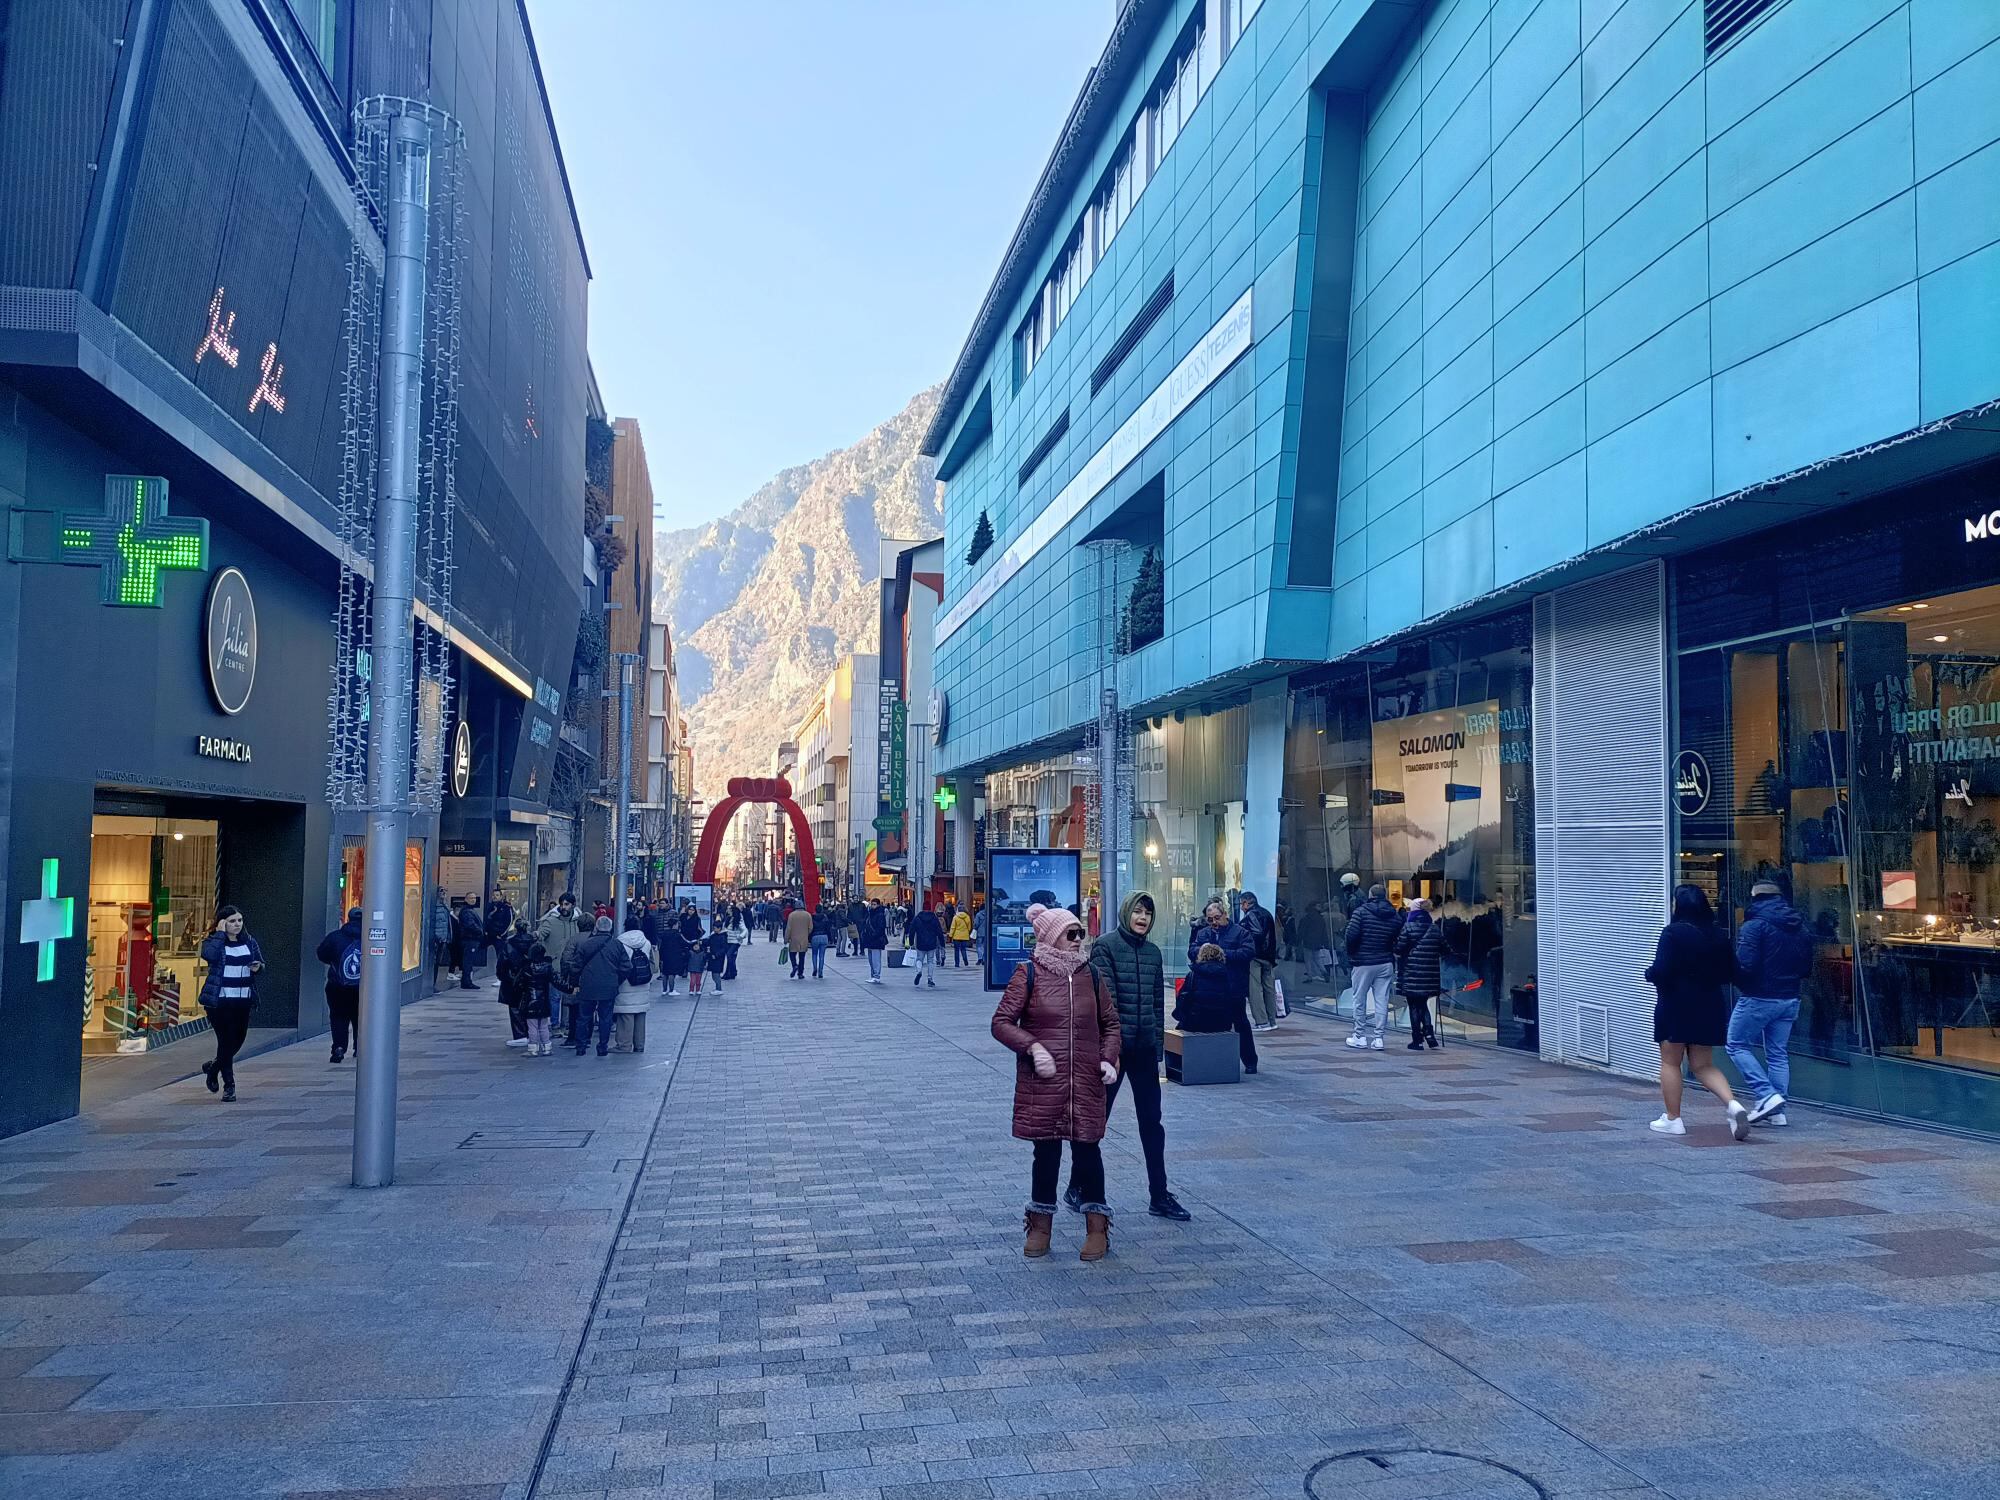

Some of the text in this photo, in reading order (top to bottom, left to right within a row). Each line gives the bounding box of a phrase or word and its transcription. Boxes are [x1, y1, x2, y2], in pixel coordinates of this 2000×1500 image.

[1172, 348, 1206, 406] GUESS
[217, 595, 249, 670] Júlia
[224, 657, 246, 673] CENTRE
[893, 703, 903, 809] CAVA BENITO
[1399, 731, 1465, 757] SALOMON
[1405, 761, 1433, 773] TOMORROW
[1434, 761, 1440, 770] IS
